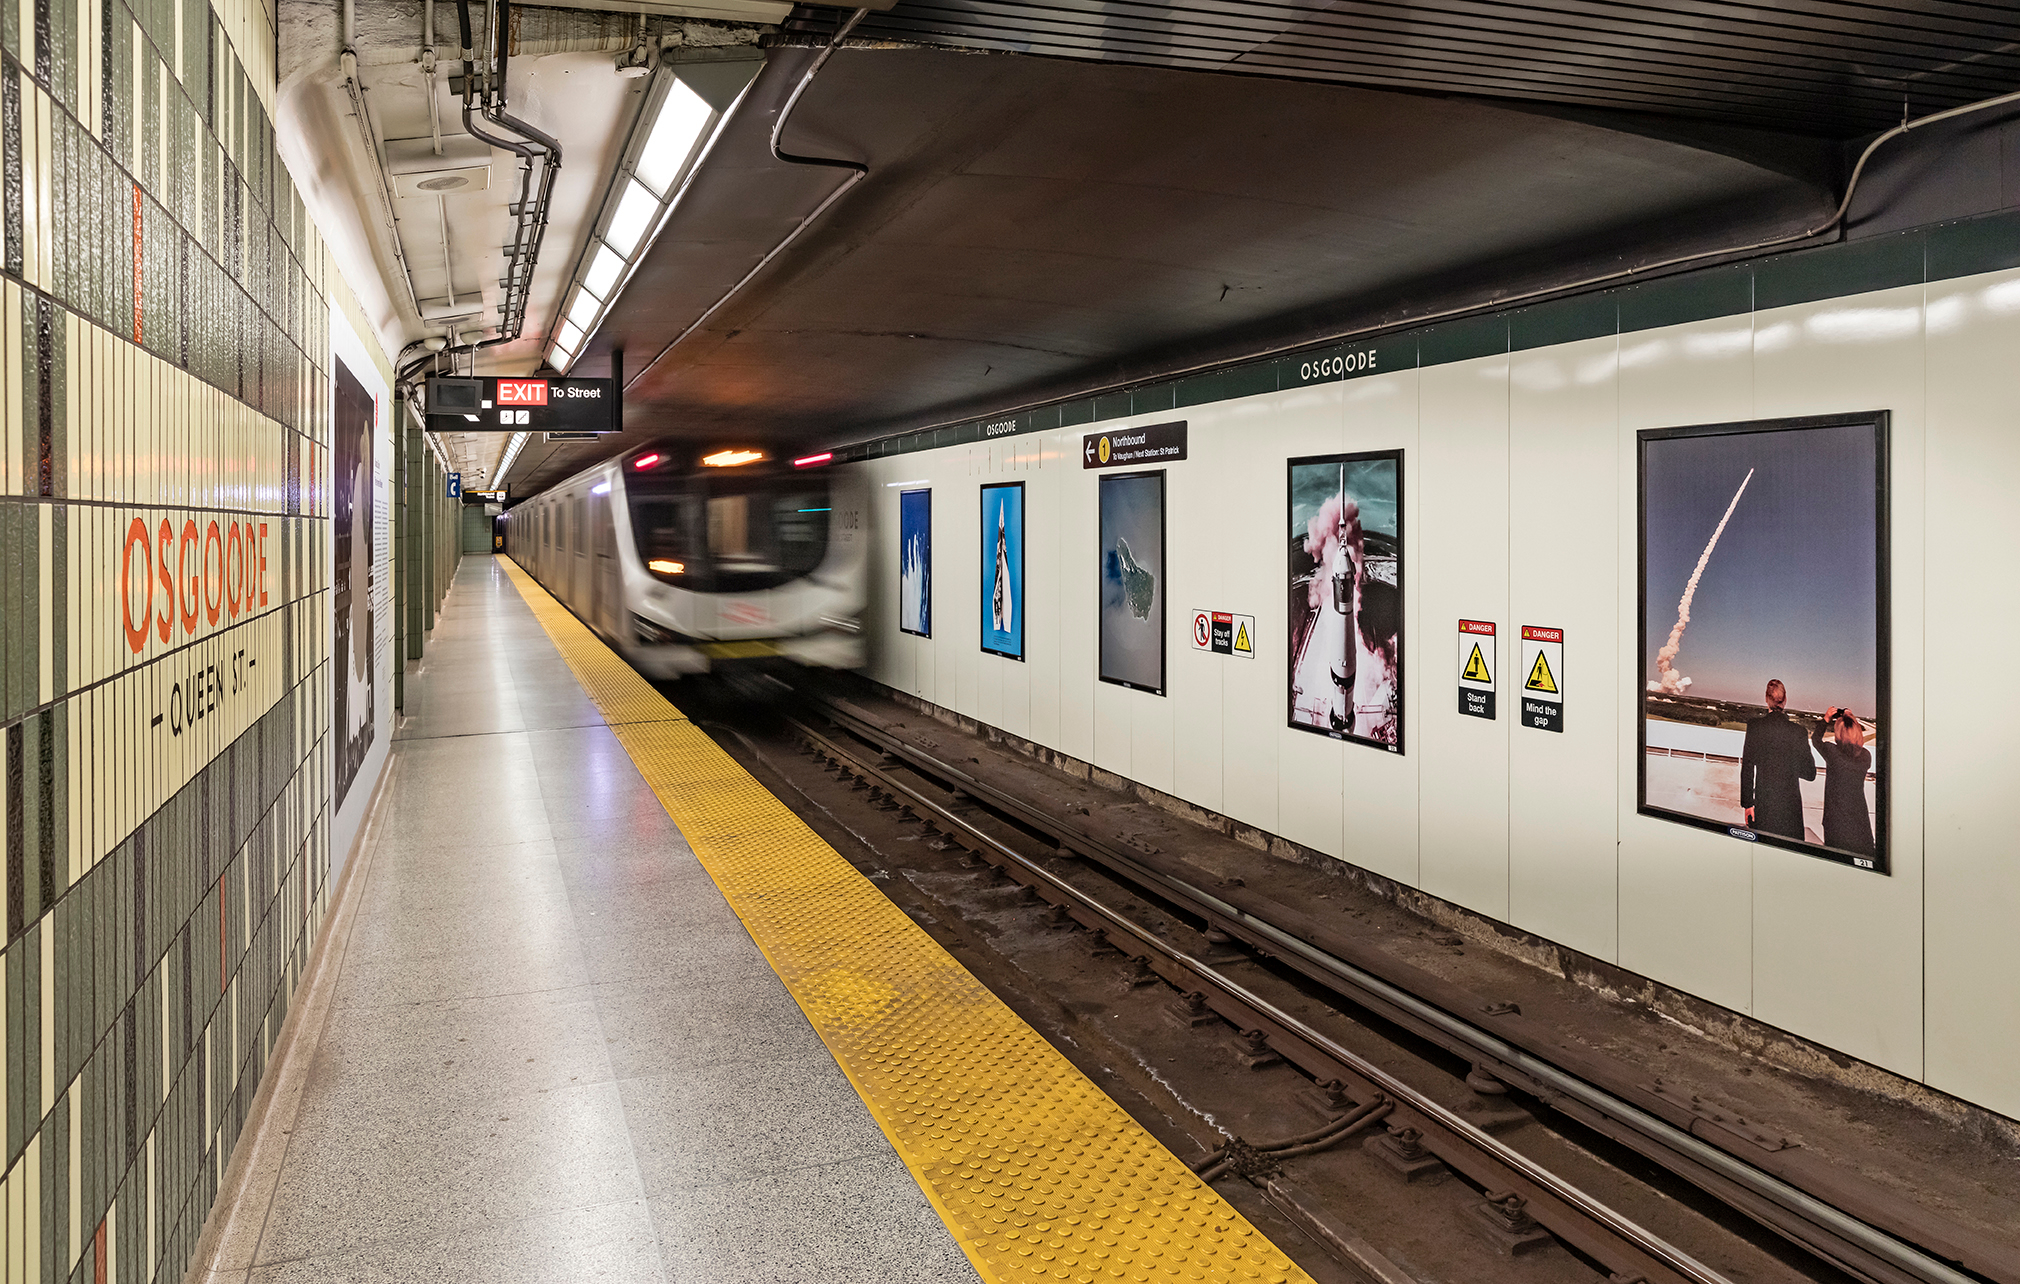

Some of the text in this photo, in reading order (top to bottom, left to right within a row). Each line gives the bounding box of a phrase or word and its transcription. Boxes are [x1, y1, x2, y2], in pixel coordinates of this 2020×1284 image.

[1300, 349, 1377, 380] OSGOODE
[499, 383, 601, 401] EXIT To Street
[986, 420, 1016, 436] OSGOODE
[1113, 433, 1145, 447] Northbound
[1113, 452, 1117, 460] To
[1117, 451, 1133, 462] Vaughan
[1135, 449, 1144, 458] Next
[1165, 446, 1179, 454] Patrick
[121, 516, 268, 655] OSGOODE
[1214, 629, 1223, 638] Stay
[1468, 623, 1493, 633] DANGER
[1532, 630, 1560, 640] DANGER
[1215, 638, 1228, 646] tracks
[170, 659, 224, 738] QUEEN
[1466, 692, 1486, 703] Stand
[1468, 703, 1485, 714] back
[1526, 702, 1557, 716] Mind the
[1534, 716, 1549, 727] gap
